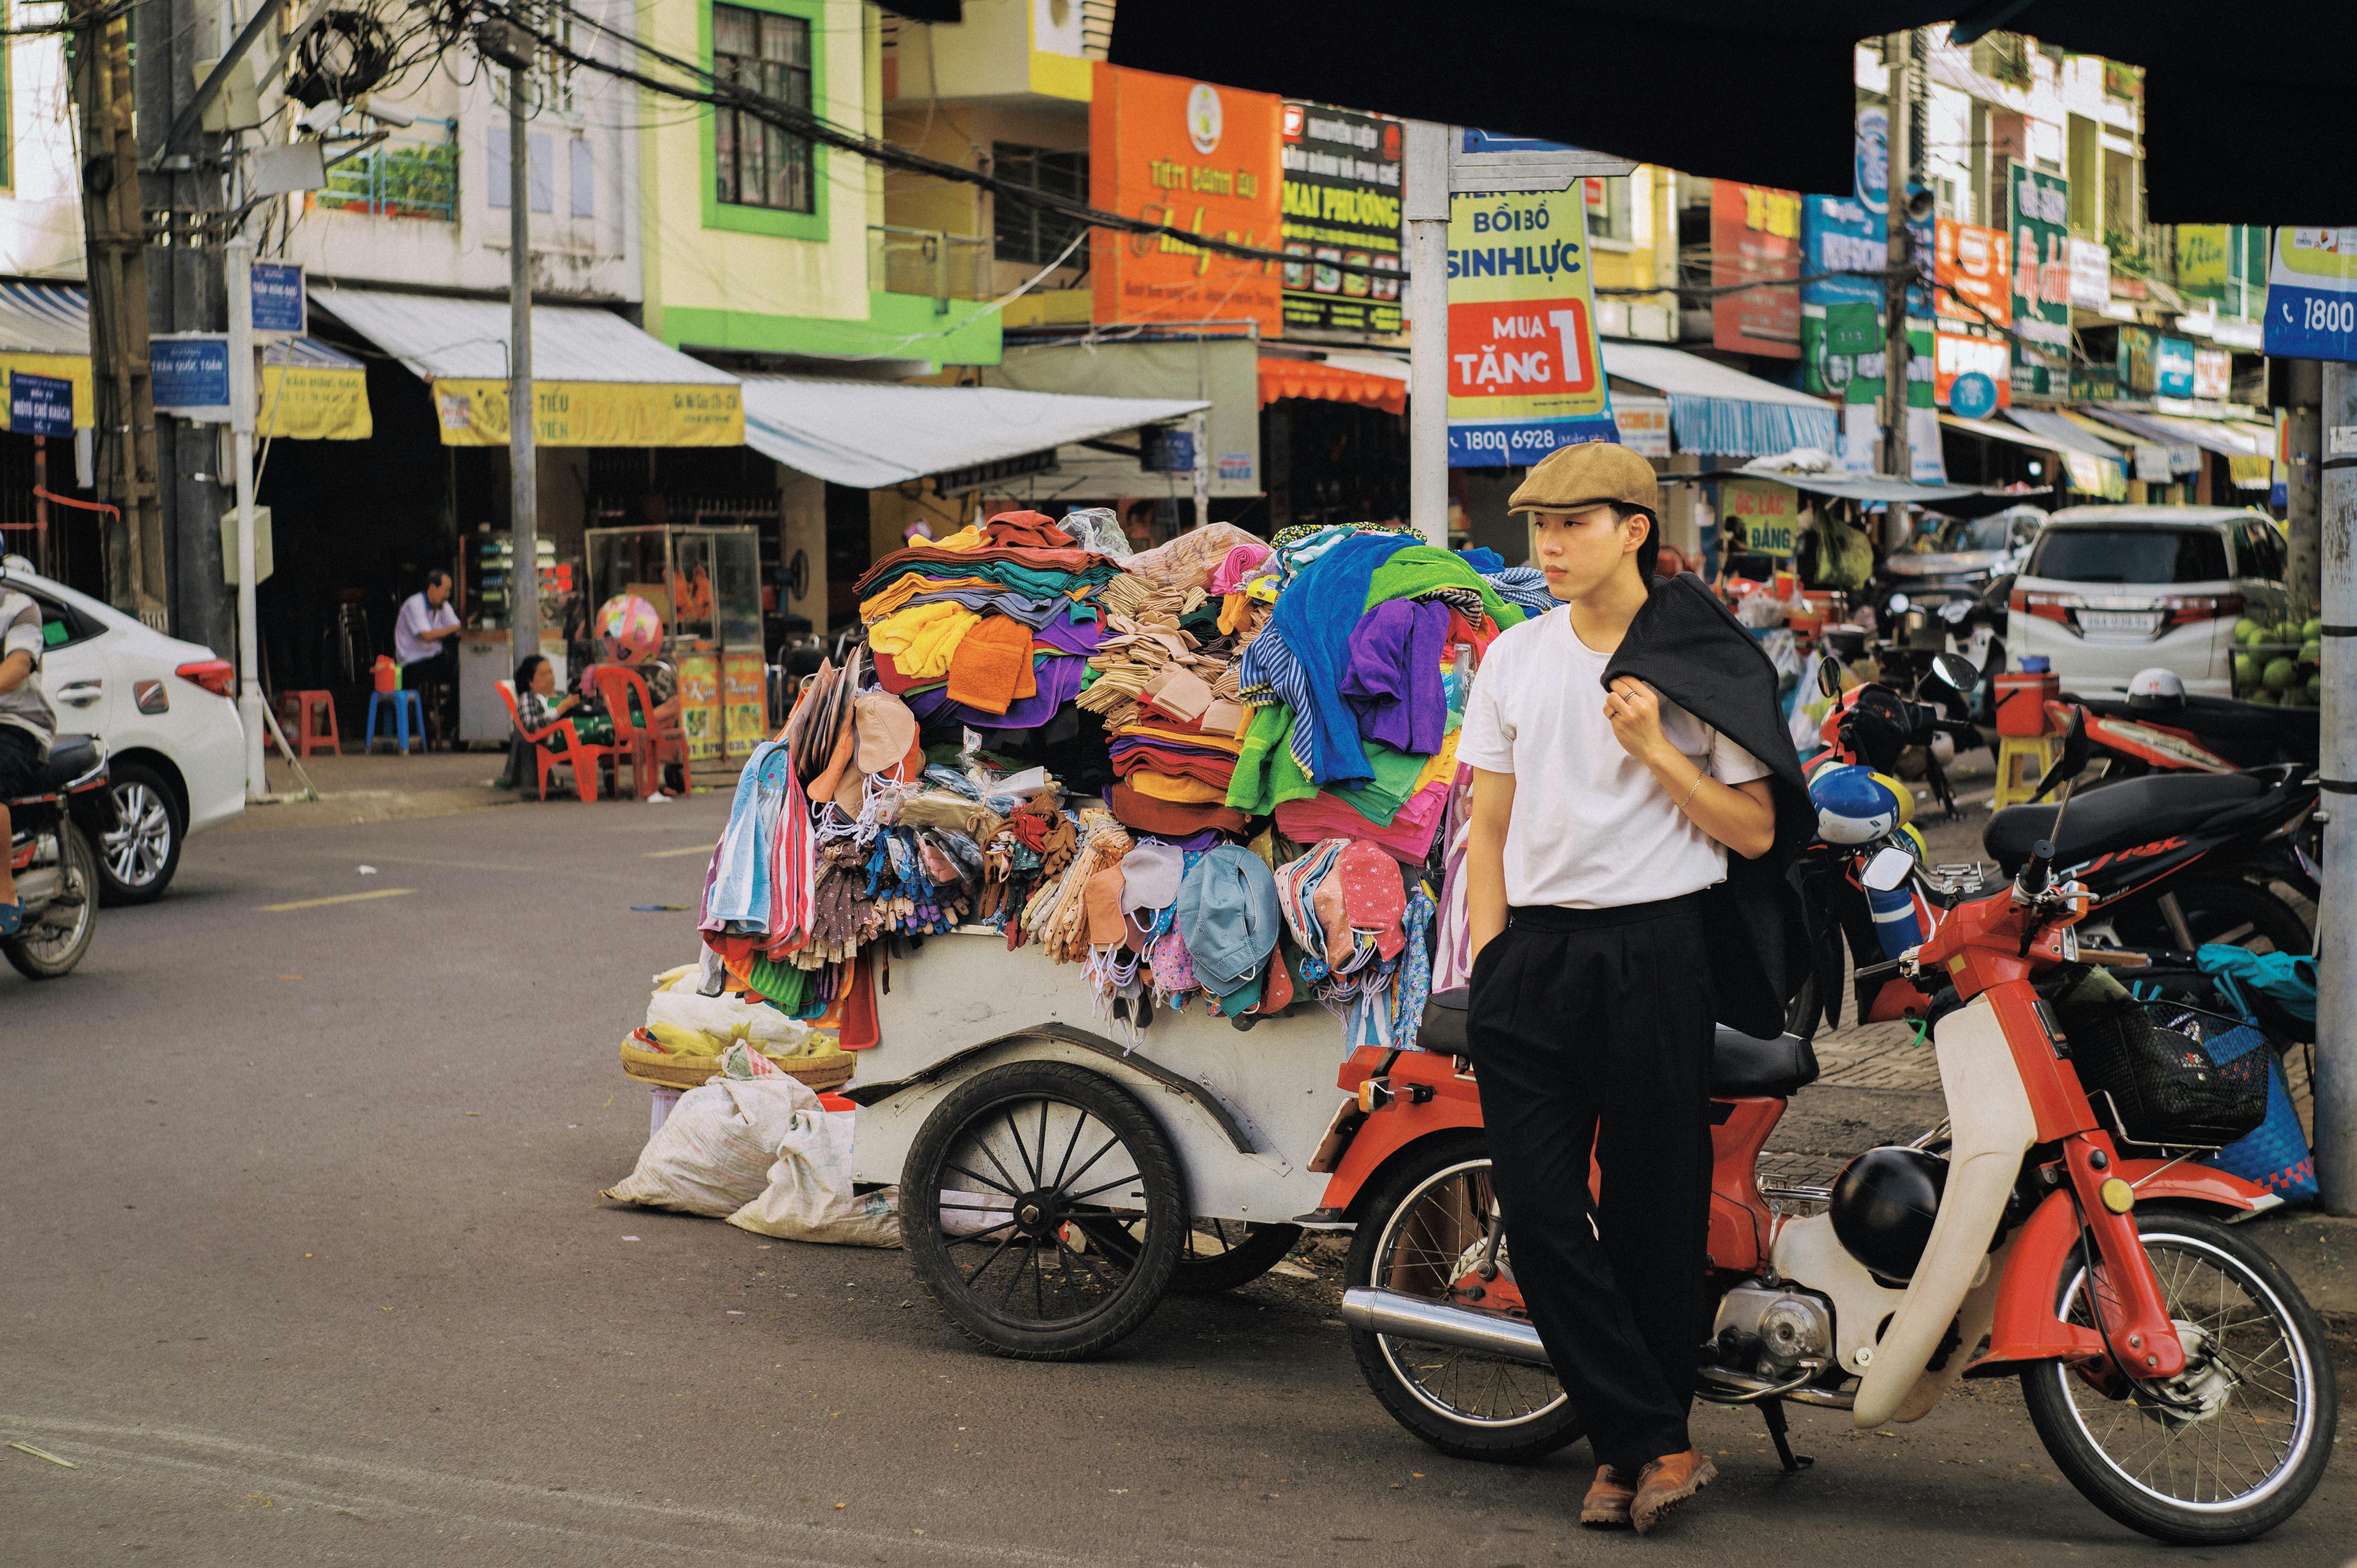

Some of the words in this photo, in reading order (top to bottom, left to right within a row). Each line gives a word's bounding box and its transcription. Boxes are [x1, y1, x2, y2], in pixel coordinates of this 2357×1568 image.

[2304, 297, 2354, 333] 1800
[1492, 315, 1546, 340] MUA
[1549, 309, 1582, 383] 1
[1453, 343, 1551, 393] TẶNG
[1465, 431, 1506, 450] 1800
[1511, 429, 1556, 449] 6928
